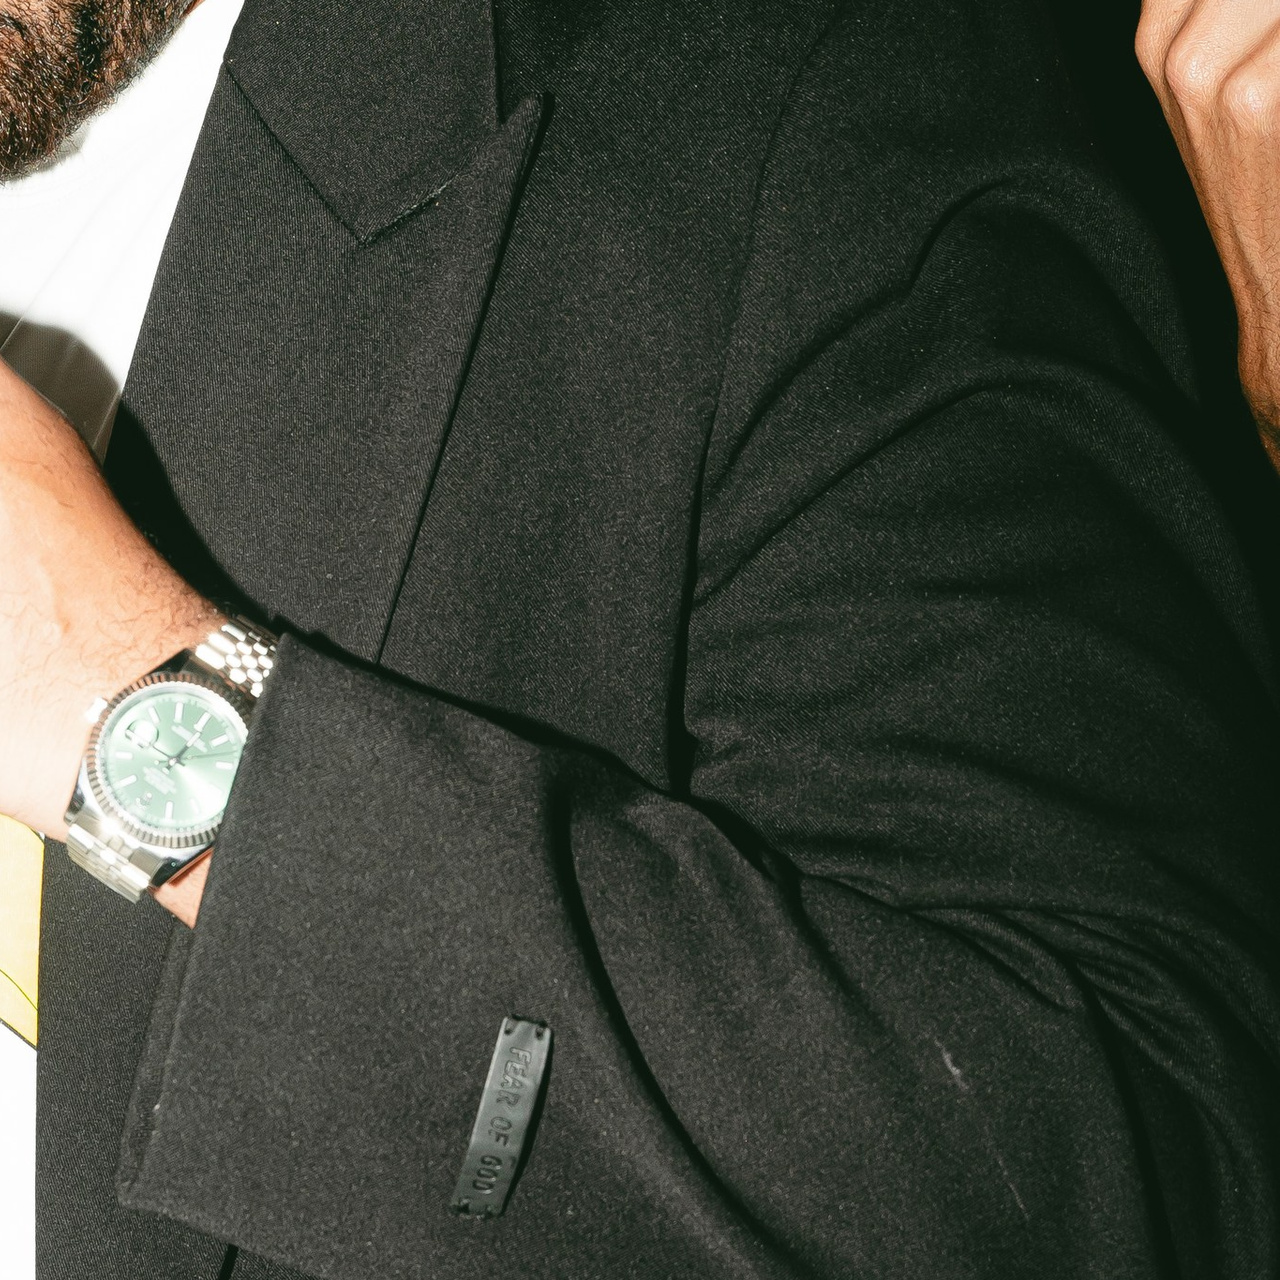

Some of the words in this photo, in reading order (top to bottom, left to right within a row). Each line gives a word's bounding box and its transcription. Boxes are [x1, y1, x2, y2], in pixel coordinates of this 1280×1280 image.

[496, 1046, 532, 1108] FEAR
[488, 1116, 512, 1146] OF
[472, 1154, 502, 1195] GOD
